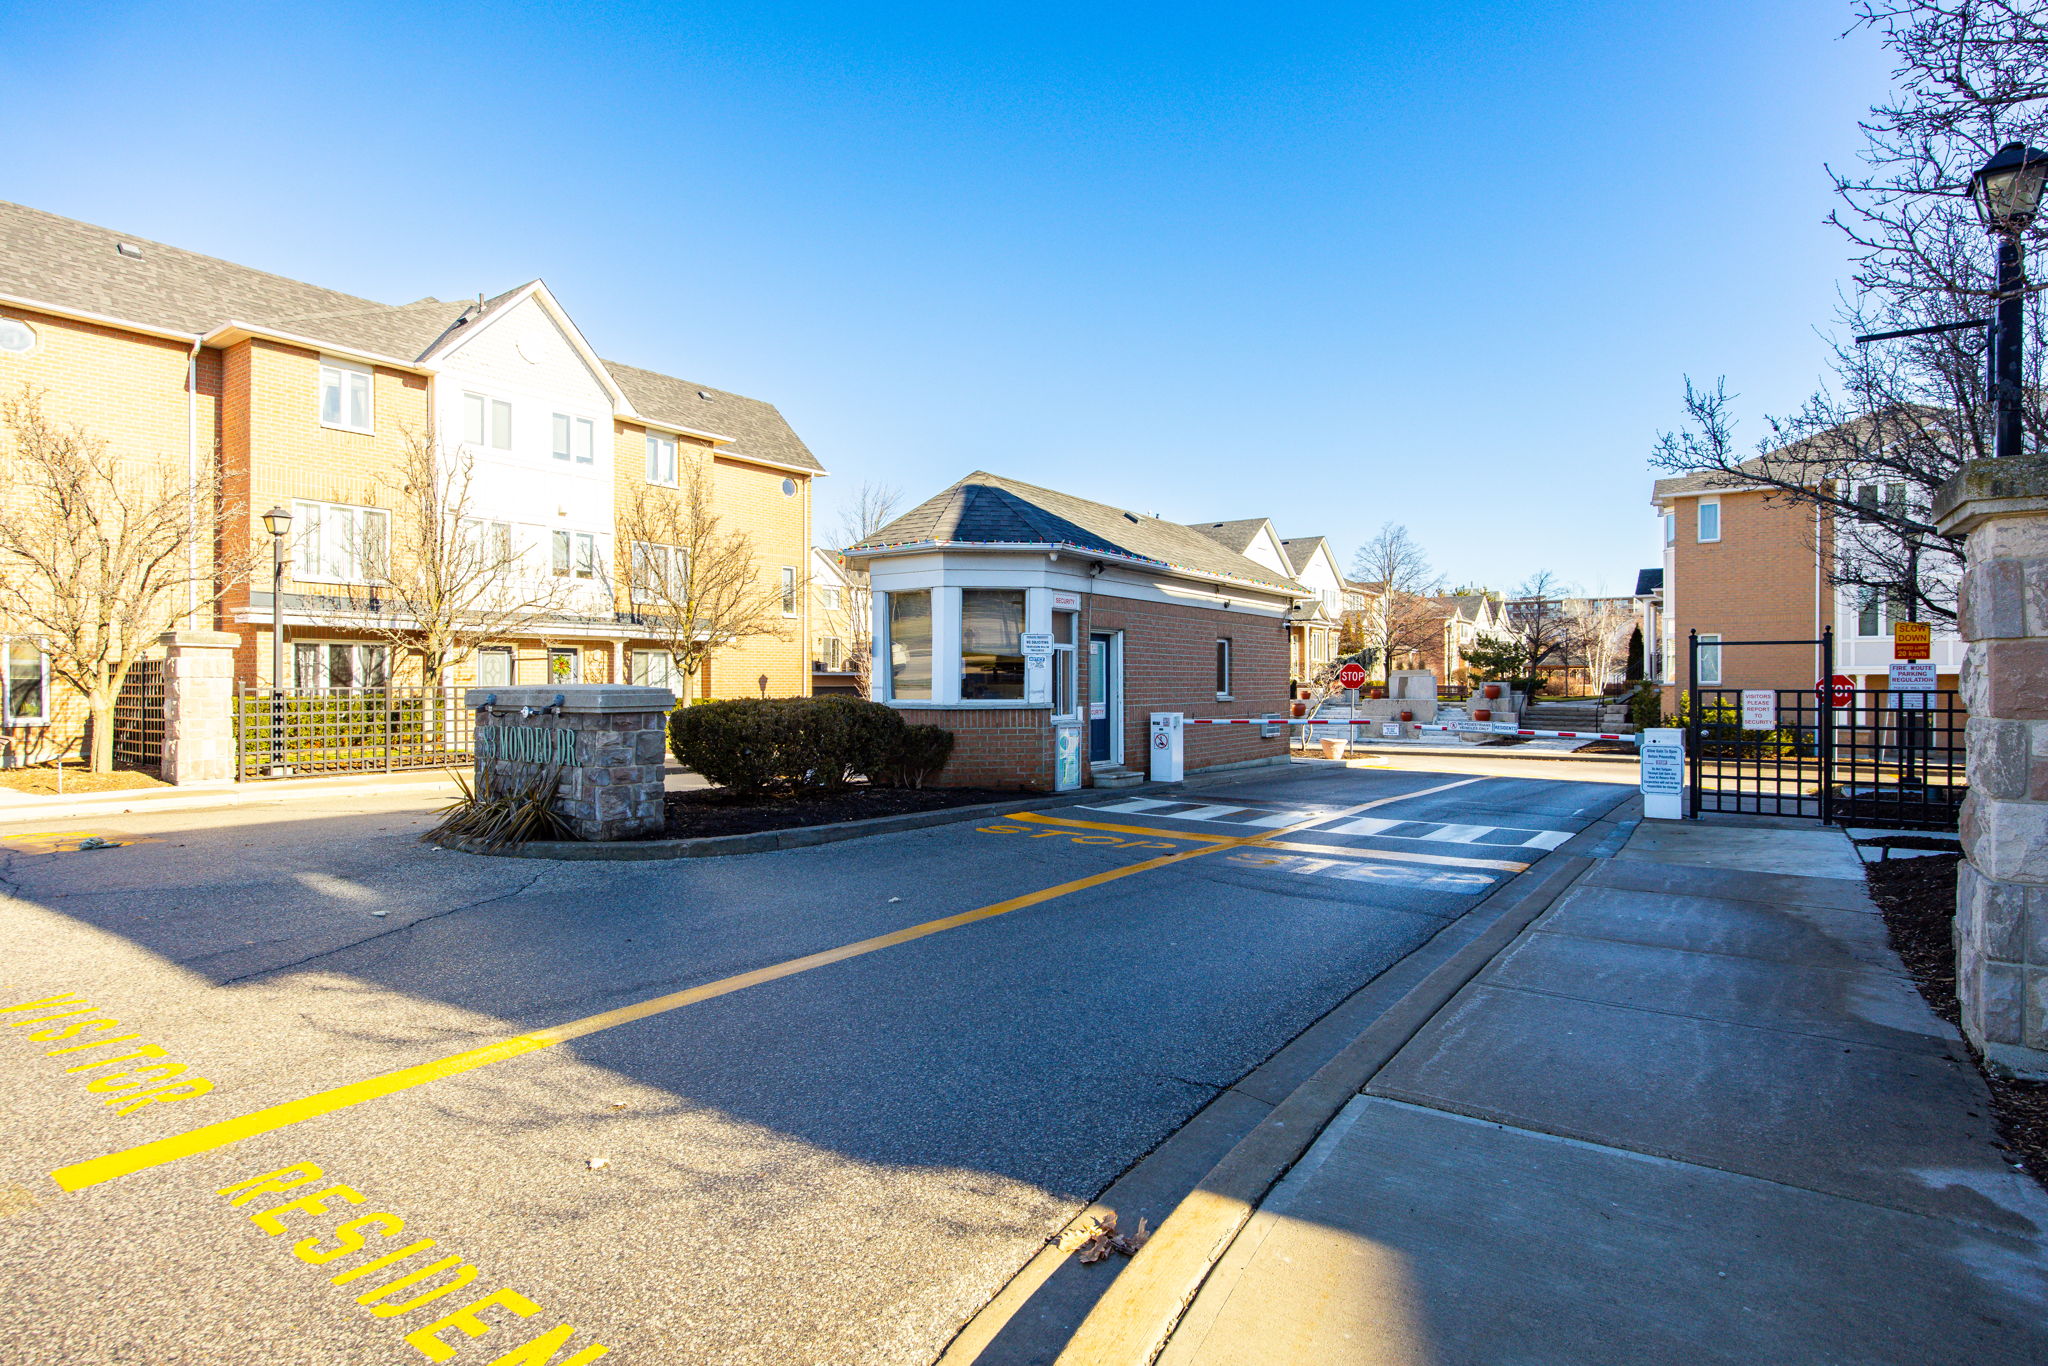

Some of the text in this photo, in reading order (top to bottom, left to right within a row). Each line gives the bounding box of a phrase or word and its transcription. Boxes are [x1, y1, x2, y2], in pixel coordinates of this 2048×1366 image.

[1055, 596, 1075, 605] SECURITY
[1899, 625, 1926, 633] SLOW
[1898, 634, 1927, 642] DOWN
[1341, 671, 1364, 681] STOP
[1818, 684, 1853, 698] SOP
[499, 725, 553, 764] MONDEO
[557, 728, 583, 767] DR.
[975, 825, 1177, 849] STOP
[1226, 852, 1499, 885] STOP
[0, 991, 215, 1117] VISITOR
